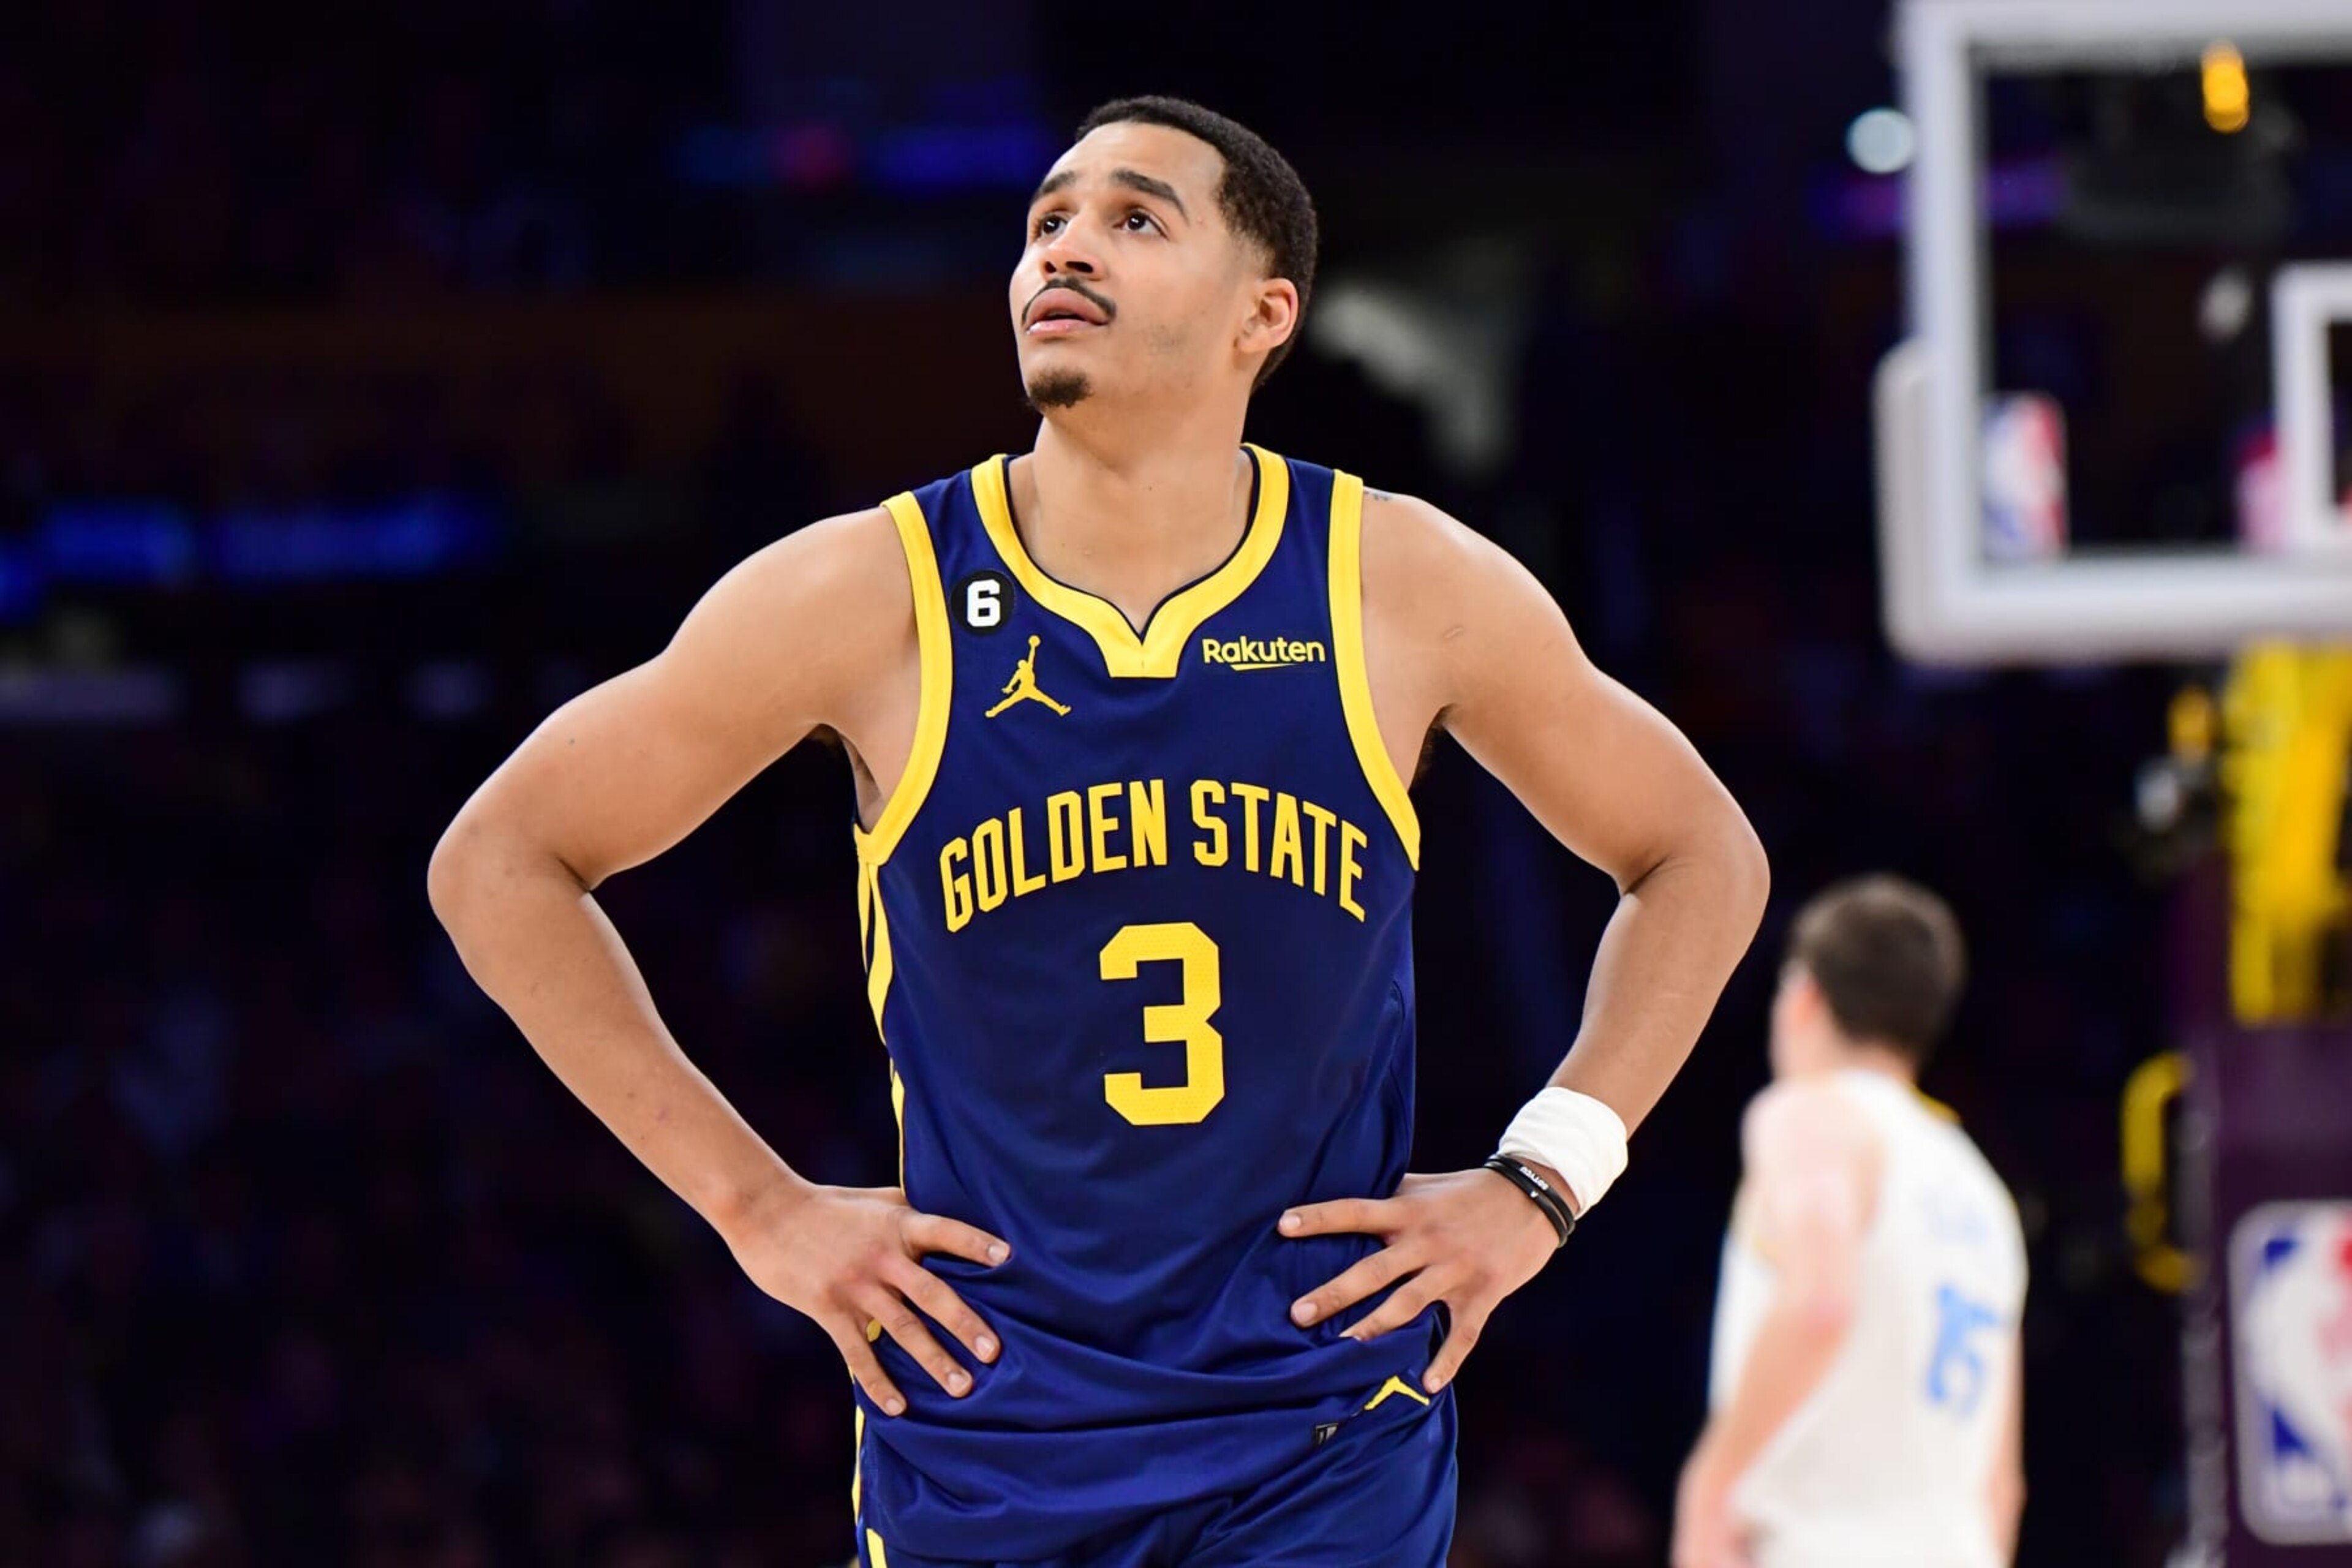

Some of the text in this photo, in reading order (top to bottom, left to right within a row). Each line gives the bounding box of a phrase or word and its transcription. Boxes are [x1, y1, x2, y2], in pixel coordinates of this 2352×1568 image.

[967, 578, 1001, 628] 6
[1202, 635, 1326, 664] Rakuten
[940, 779, 1368, 933] GOLDEN STATE
[1099, 922, 1225, 1126] 3
